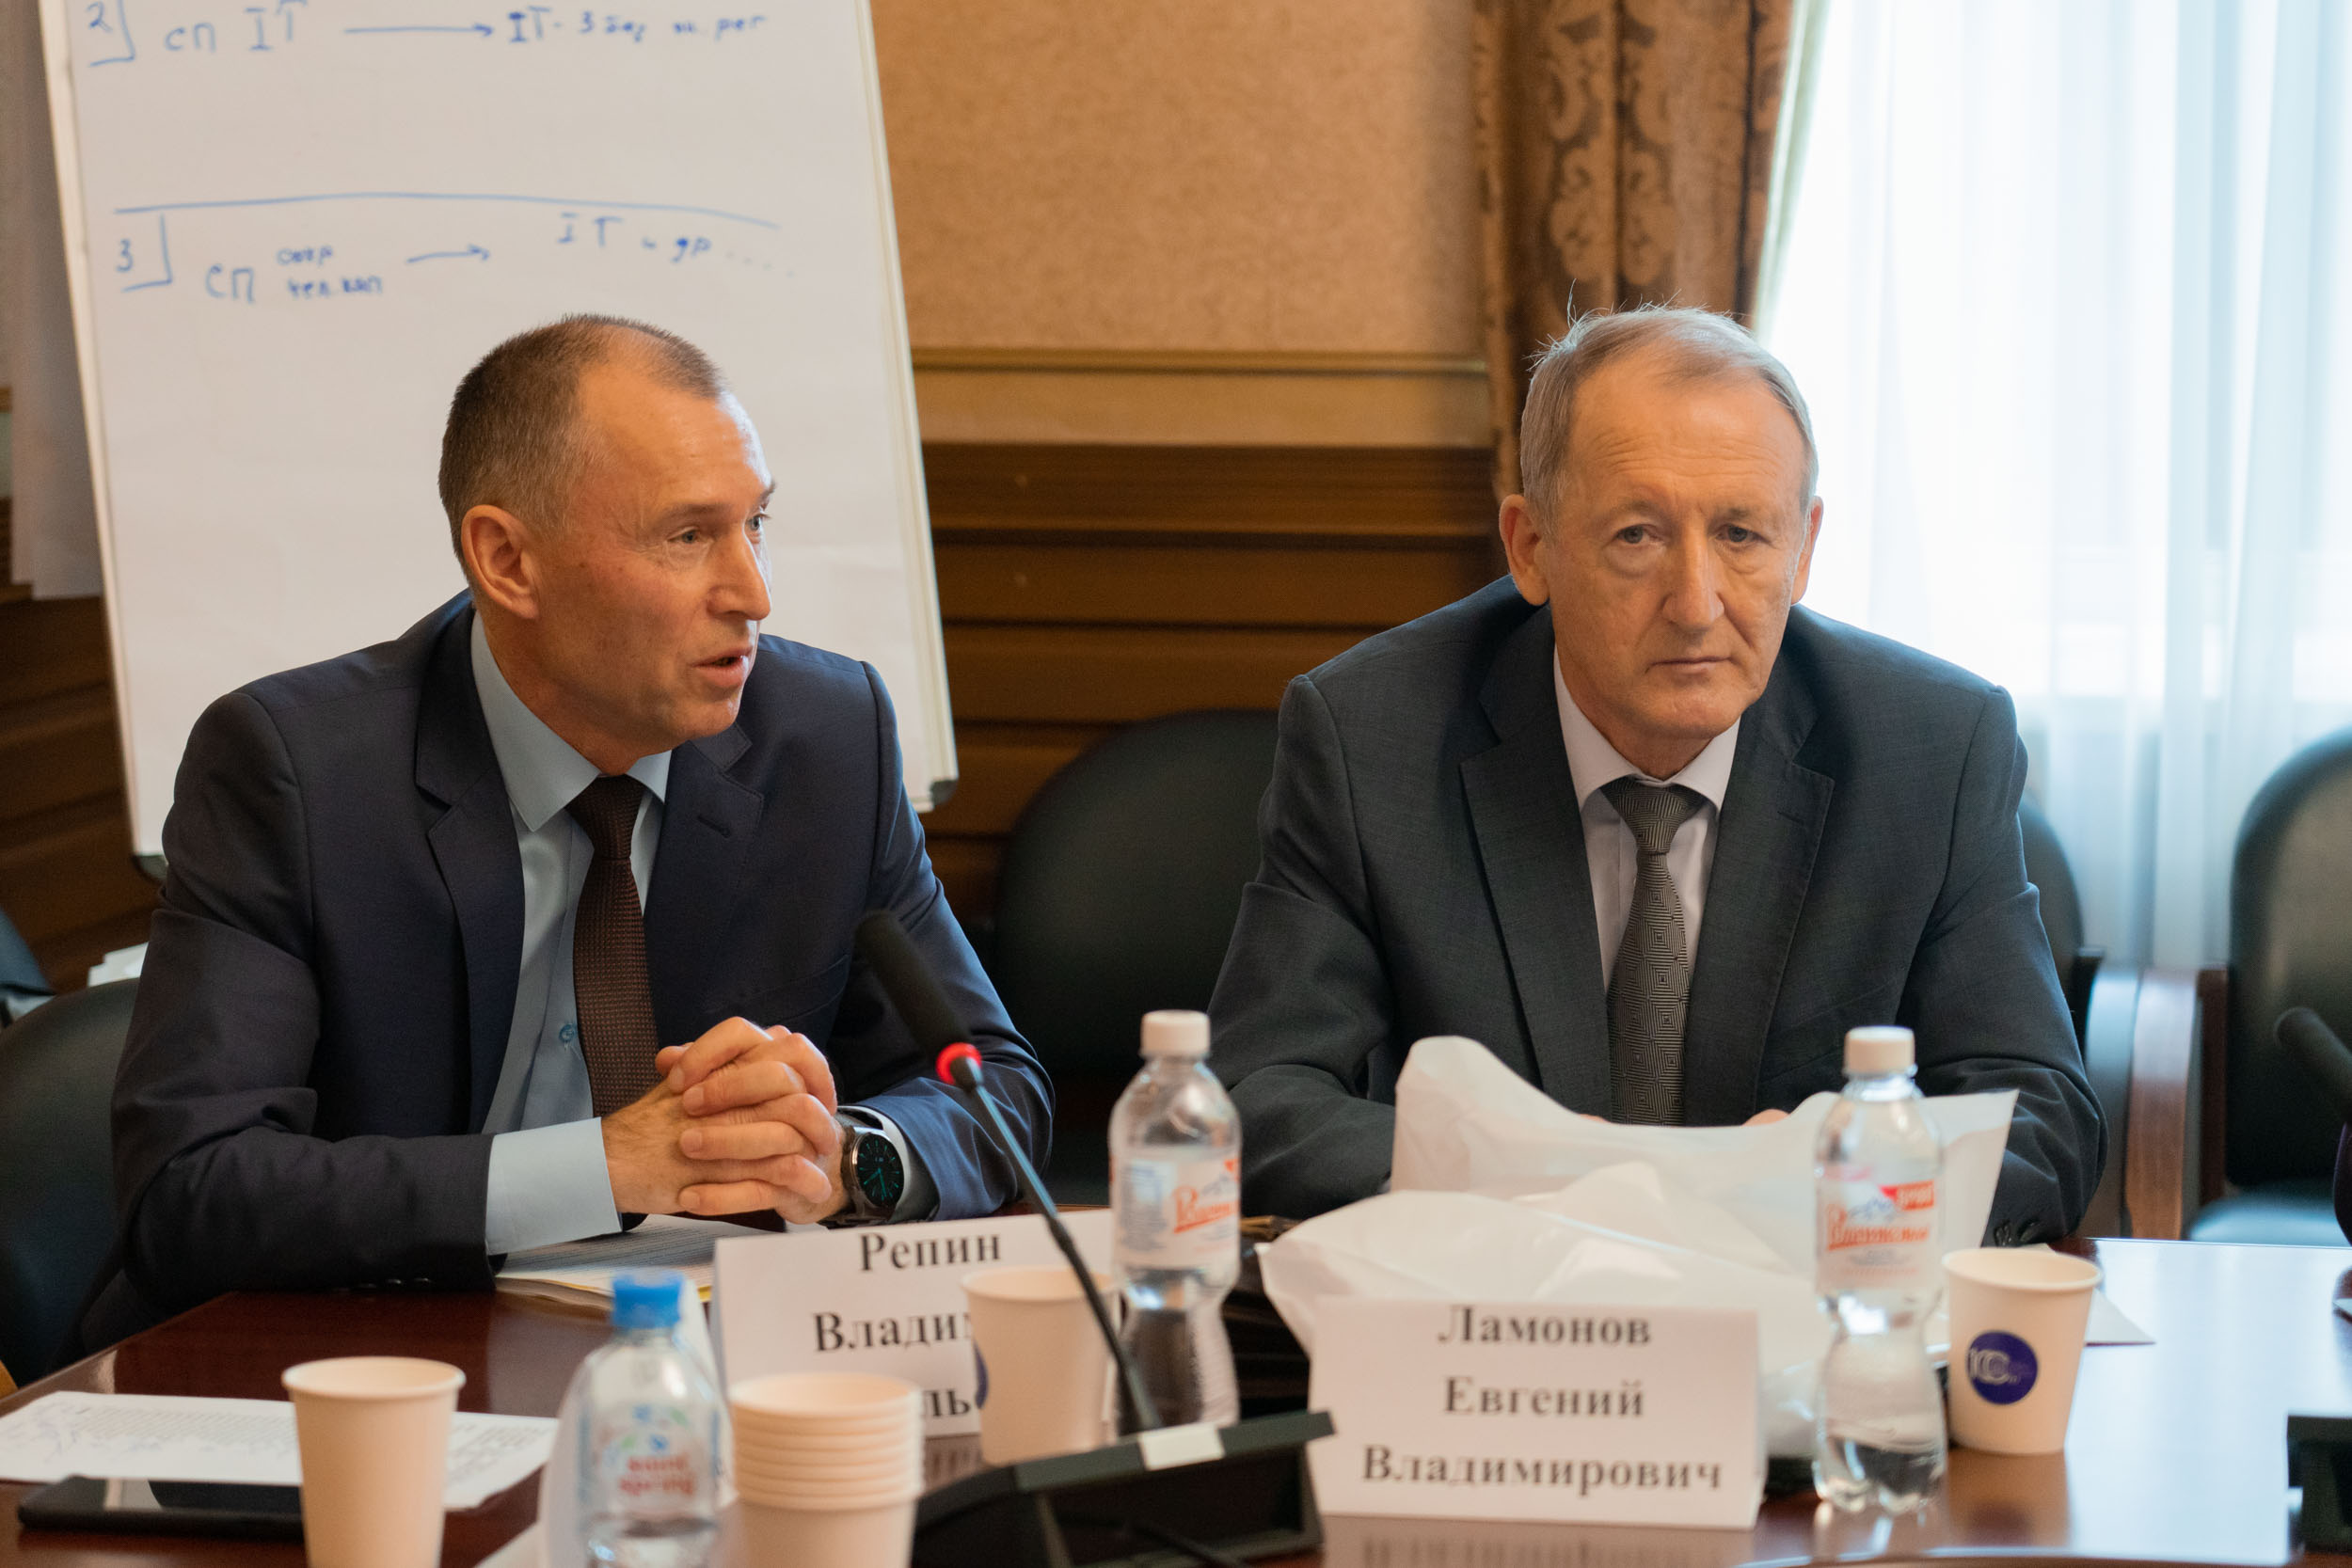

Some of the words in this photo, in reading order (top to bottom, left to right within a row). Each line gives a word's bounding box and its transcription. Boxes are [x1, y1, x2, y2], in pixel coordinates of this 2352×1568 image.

[858, 1231, 1002, 1273] Репин
[813, 1311, 970, 1353] Влади
[1437, 1305, 1652, 1347] Ламонов
[1443, 1375, 1645, 1418] Евгений
[1361, 1444, 1723, 1498] Владимирович
